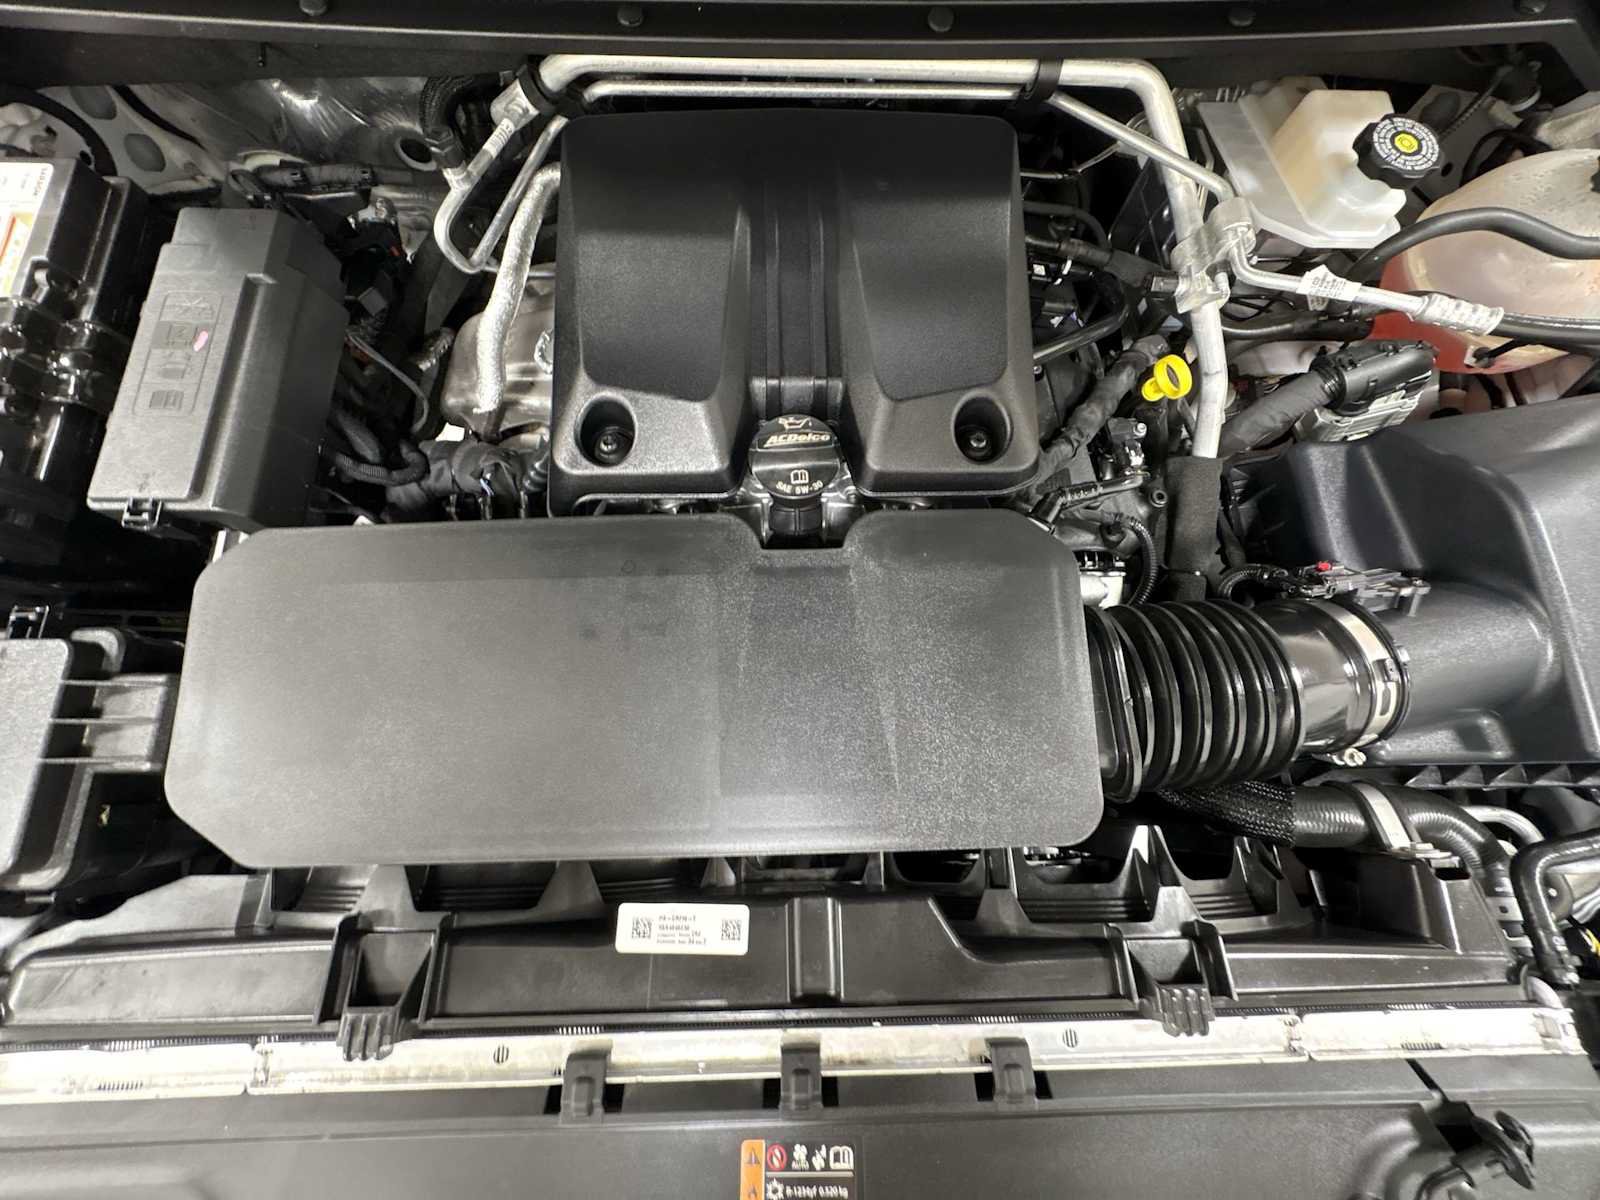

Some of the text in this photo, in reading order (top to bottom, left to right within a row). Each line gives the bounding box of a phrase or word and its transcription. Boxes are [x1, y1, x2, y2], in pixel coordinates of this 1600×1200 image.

[763, 433, 831, 447] ACDelco
[776, 480, 824, 494] SAE 5W-30
